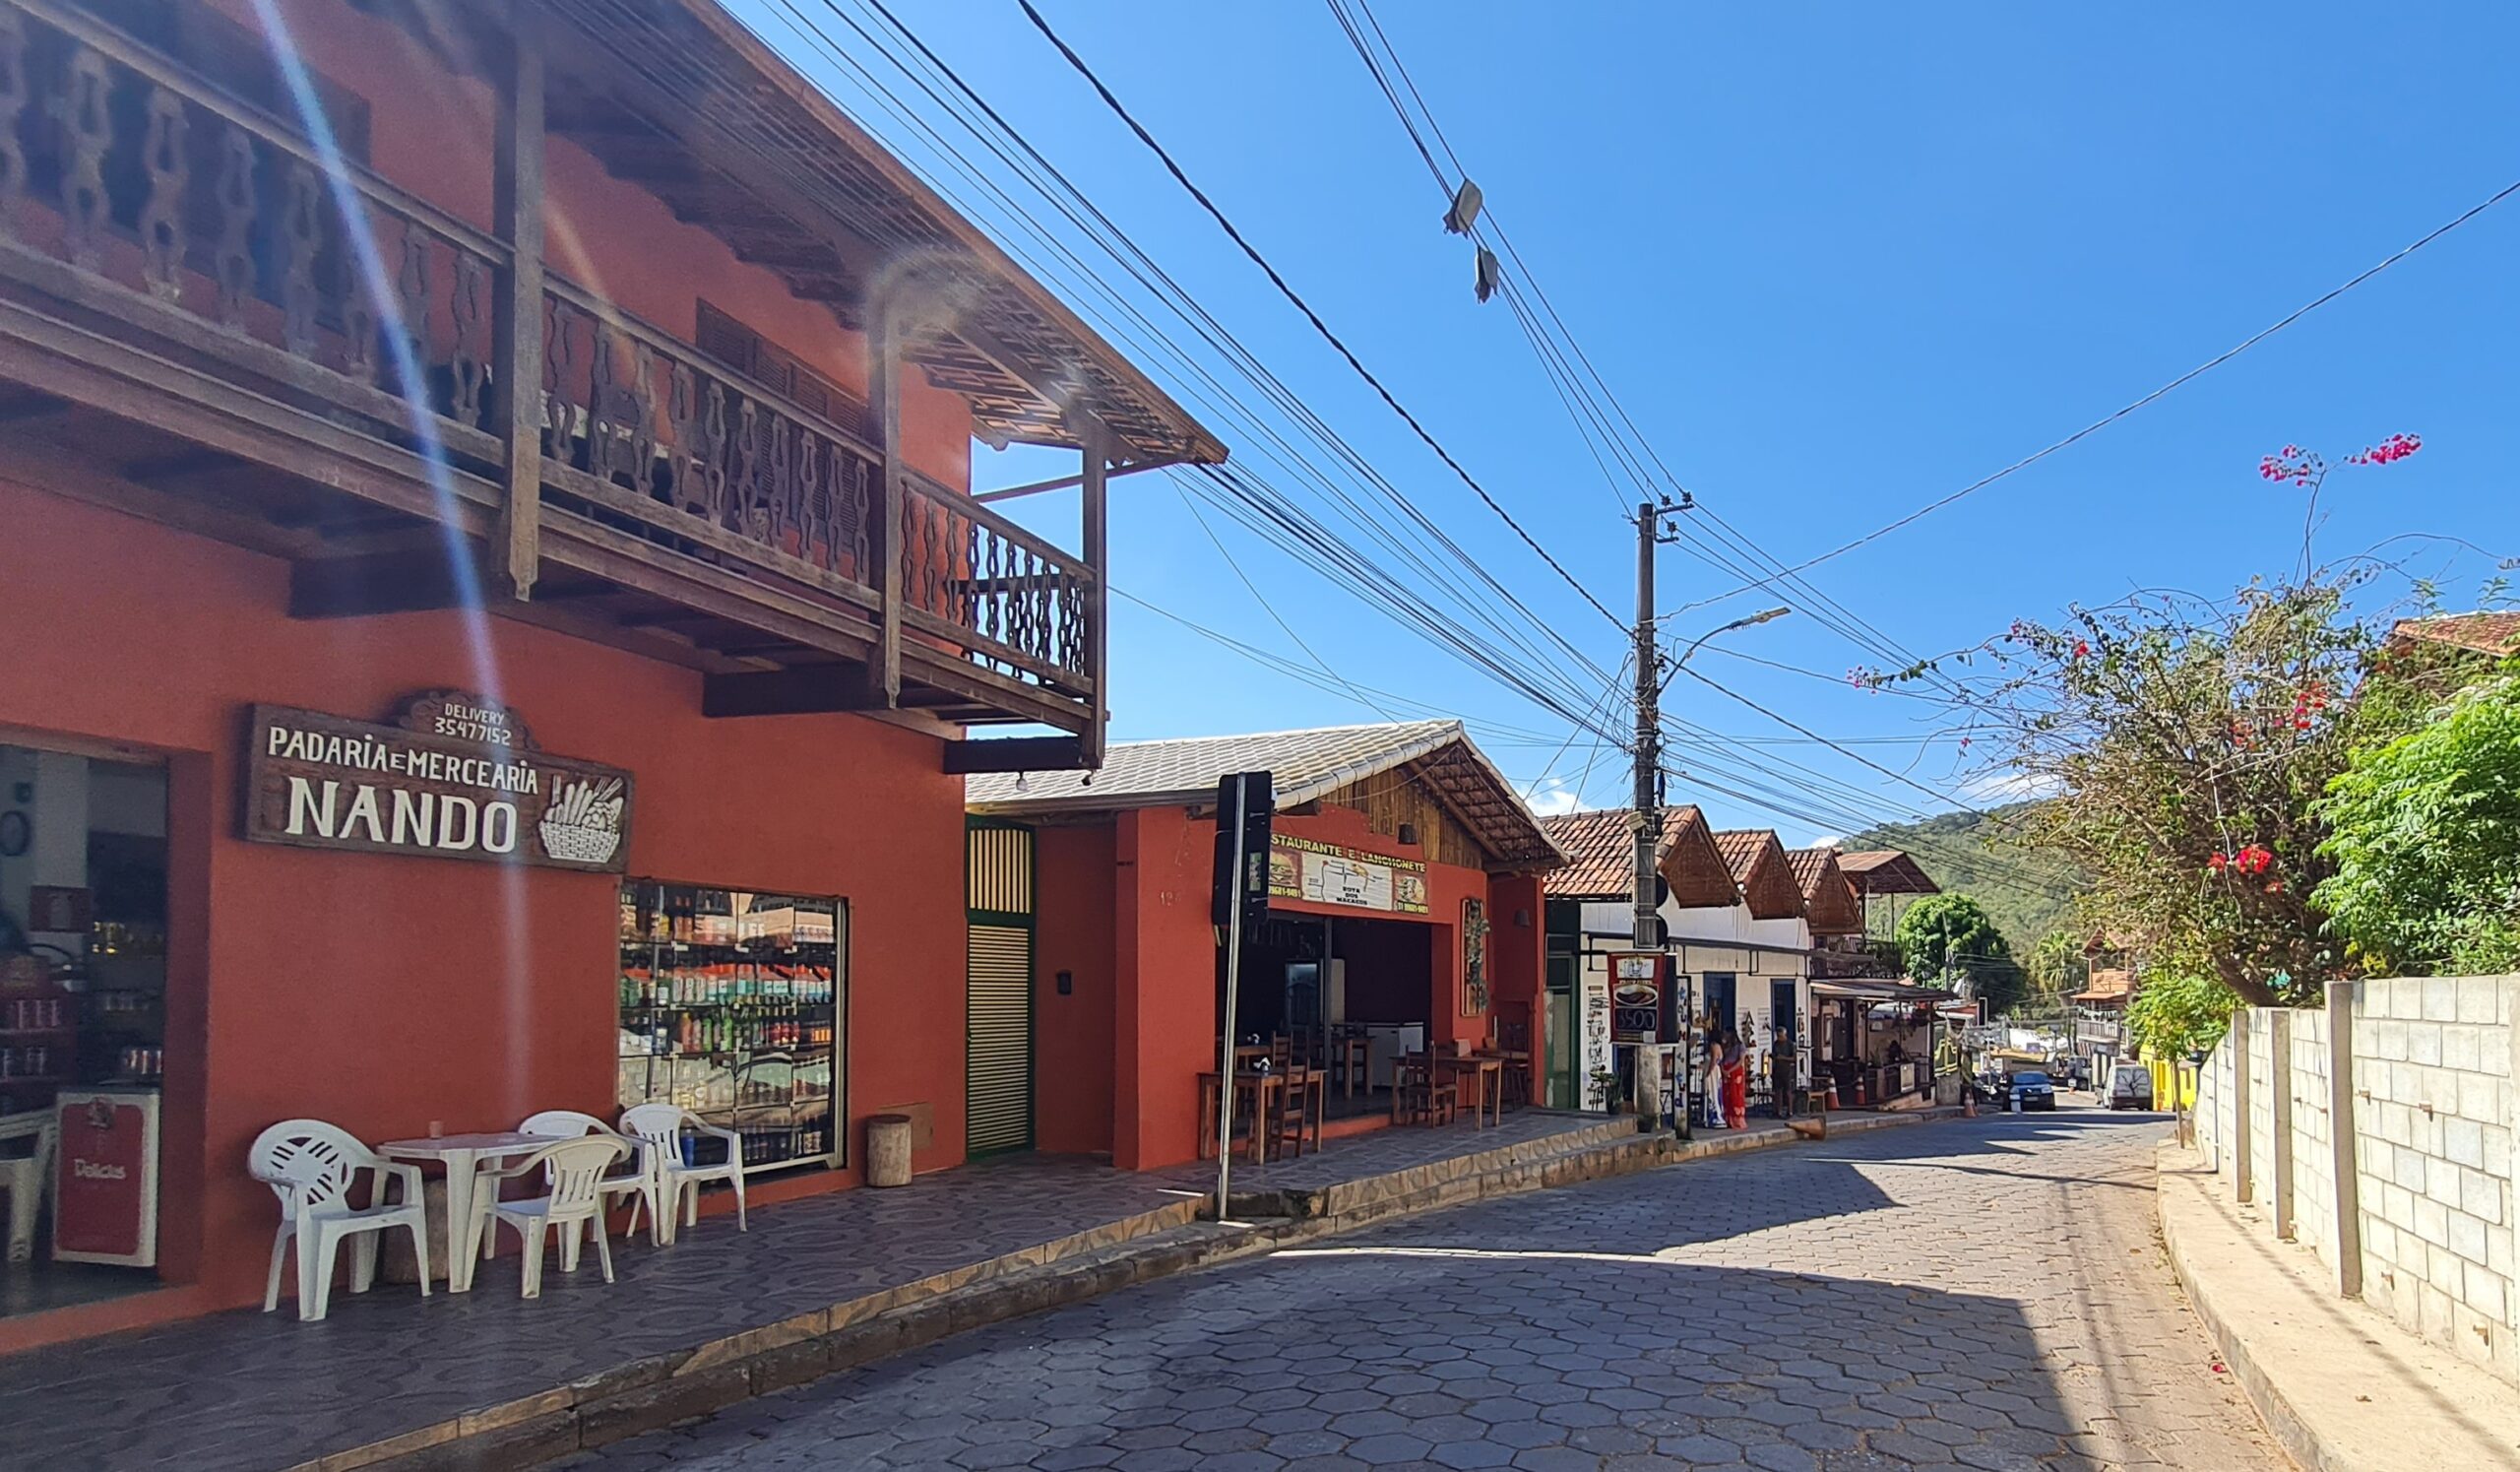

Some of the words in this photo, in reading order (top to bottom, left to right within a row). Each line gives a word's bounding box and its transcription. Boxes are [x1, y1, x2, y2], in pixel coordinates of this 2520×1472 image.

[445, 703, 505, 726] DELIVERY
[434, 717, 512, 746] 35477152
[390, 752, 407, 769] E
[284, 776, 517, 853] NANDO
[1271, 834, 1343, 858] STAURANTE
[1348, 849, 1356, 860] E
[1360, 852, 1426, 873] LANCHONETE
